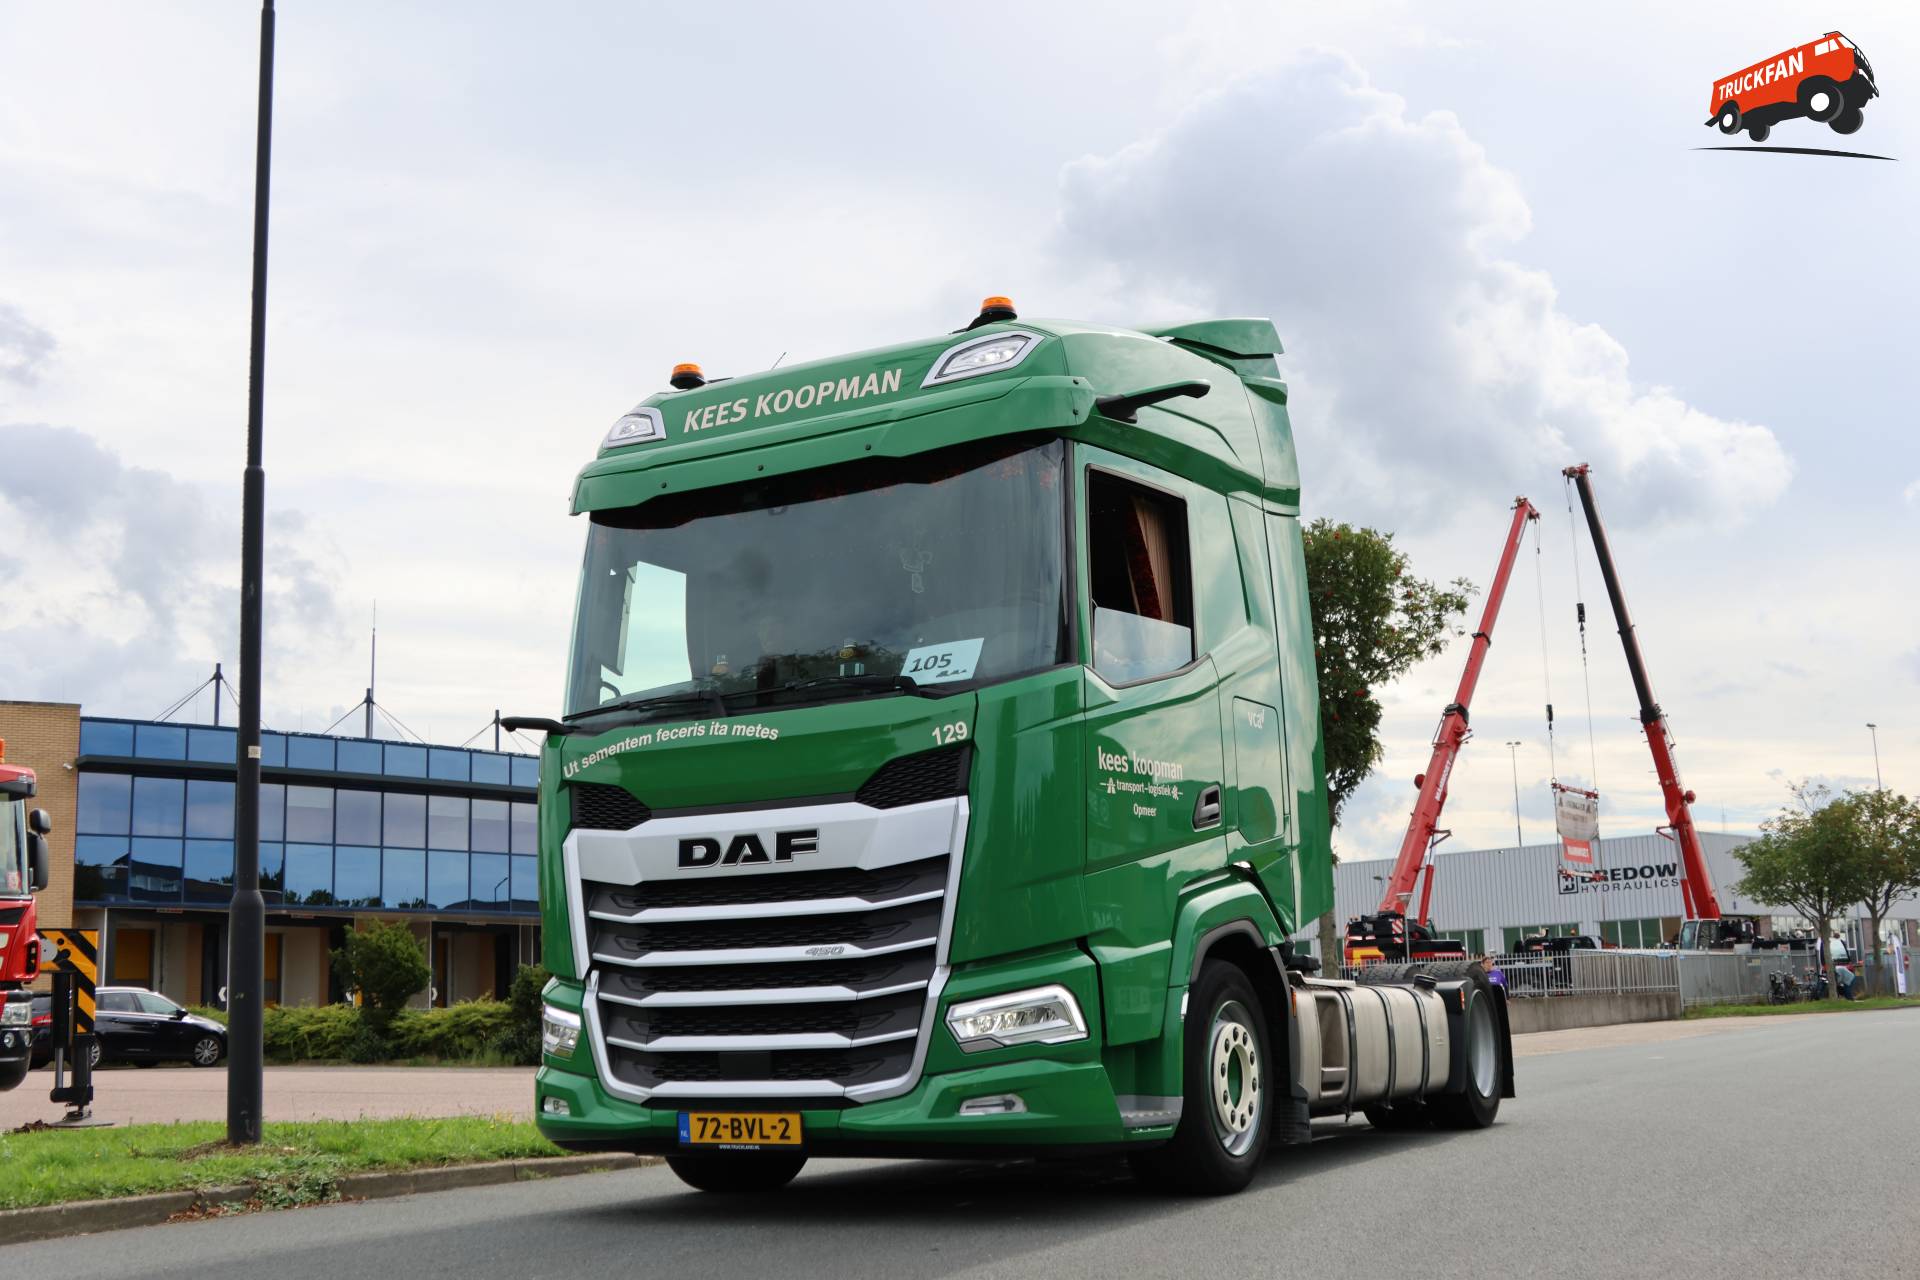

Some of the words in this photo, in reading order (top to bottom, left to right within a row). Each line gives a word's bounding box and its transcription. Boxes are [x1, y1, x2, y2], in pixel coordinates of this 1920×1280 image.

[683, 398, 748, 433] KEES
[754, 368, 902, 418] KOOPMAN
[909, 653, 953, 673] 105
[932, 721, 968, 746] 129
[563, 760, 580, 778] Ut
[581, 733, 652, 769] sementem
[656, 722, 706, 742] feceris
[709, 721, 728, 736] ita
[731, 723, 779, 741] metes
[1098, 745, 1129, 773] kees
[1132, 751, 1183, 782] koopman
[1133, 803, 1157, 818] Opmeer
[677, 827, 820, 870] DAF
[1581, 878, 1680, 894] HYDRAULICS
[680, 1130, 689, 1138] NL
[696, 1117, 792, 1140] 72-BVL-2
